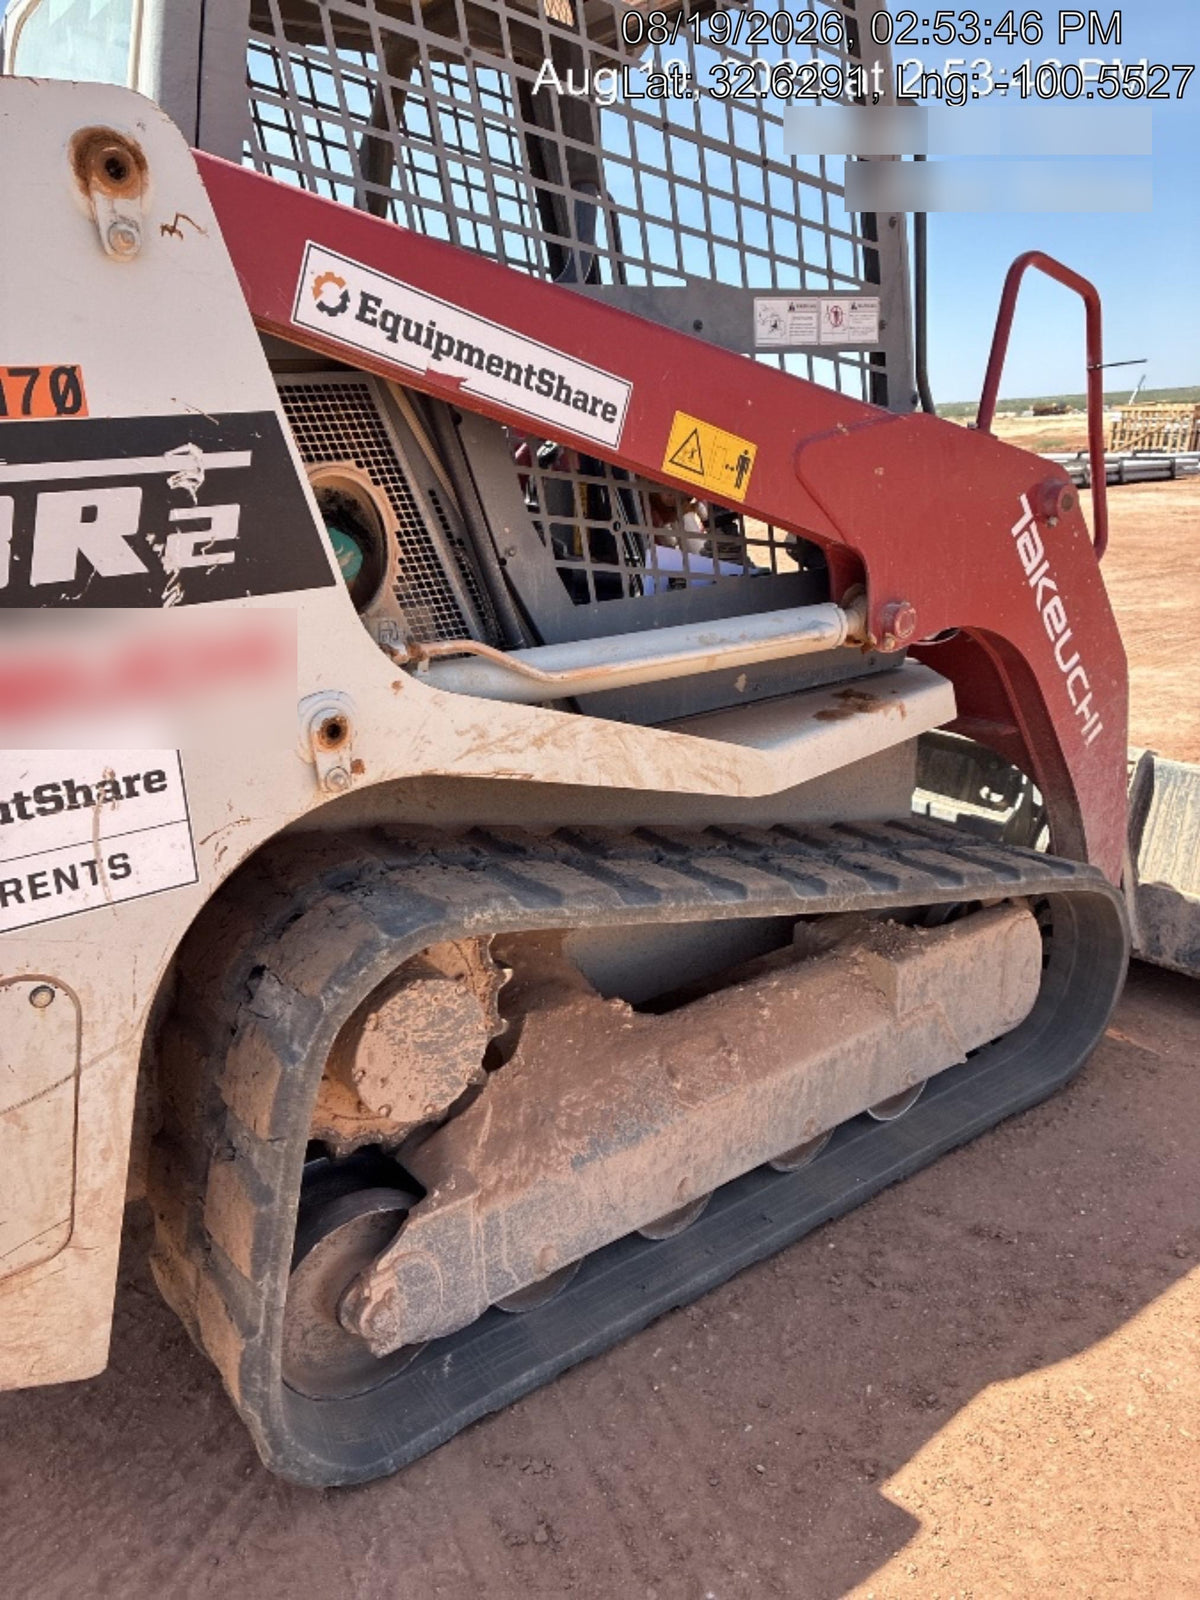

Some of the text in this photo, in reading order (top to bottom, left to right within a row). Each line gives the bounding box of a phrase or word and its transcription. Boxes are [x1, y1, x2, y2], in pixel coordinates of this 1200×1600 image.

[354, 290, 618, 424] EquipmentShare
[0, 366, 82, 416] 70
[0, 853, 132, 908] RENTS
